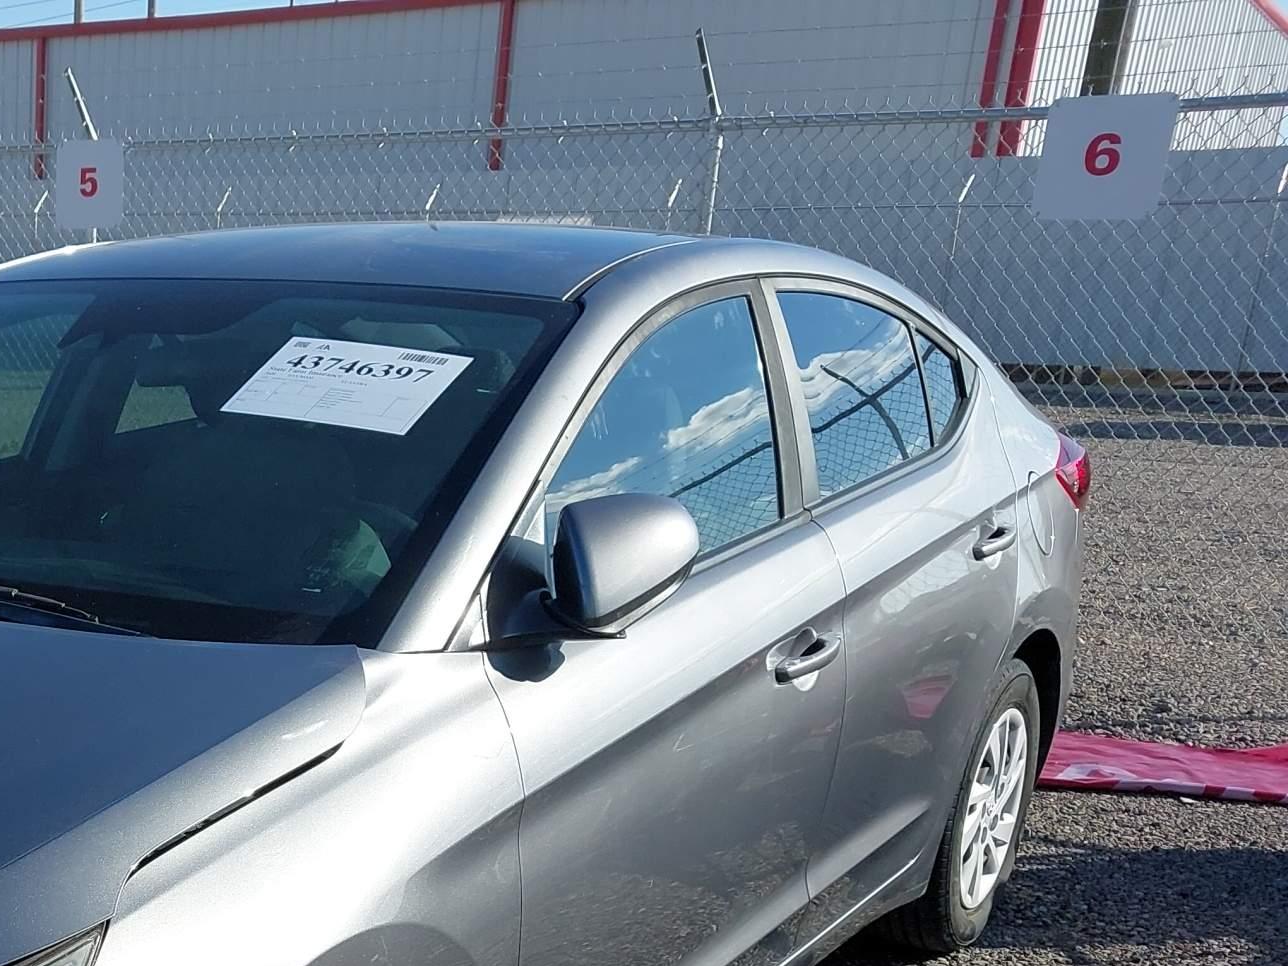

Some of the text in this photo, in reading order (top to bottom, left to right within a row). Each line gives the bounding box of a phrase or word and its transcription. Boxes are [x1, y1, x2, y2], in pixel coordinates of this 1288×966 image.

[1084, 132, 1122, 176] 6
[79, 166, 99, 198] 5
[286, 354, 435, 383] 43746397
